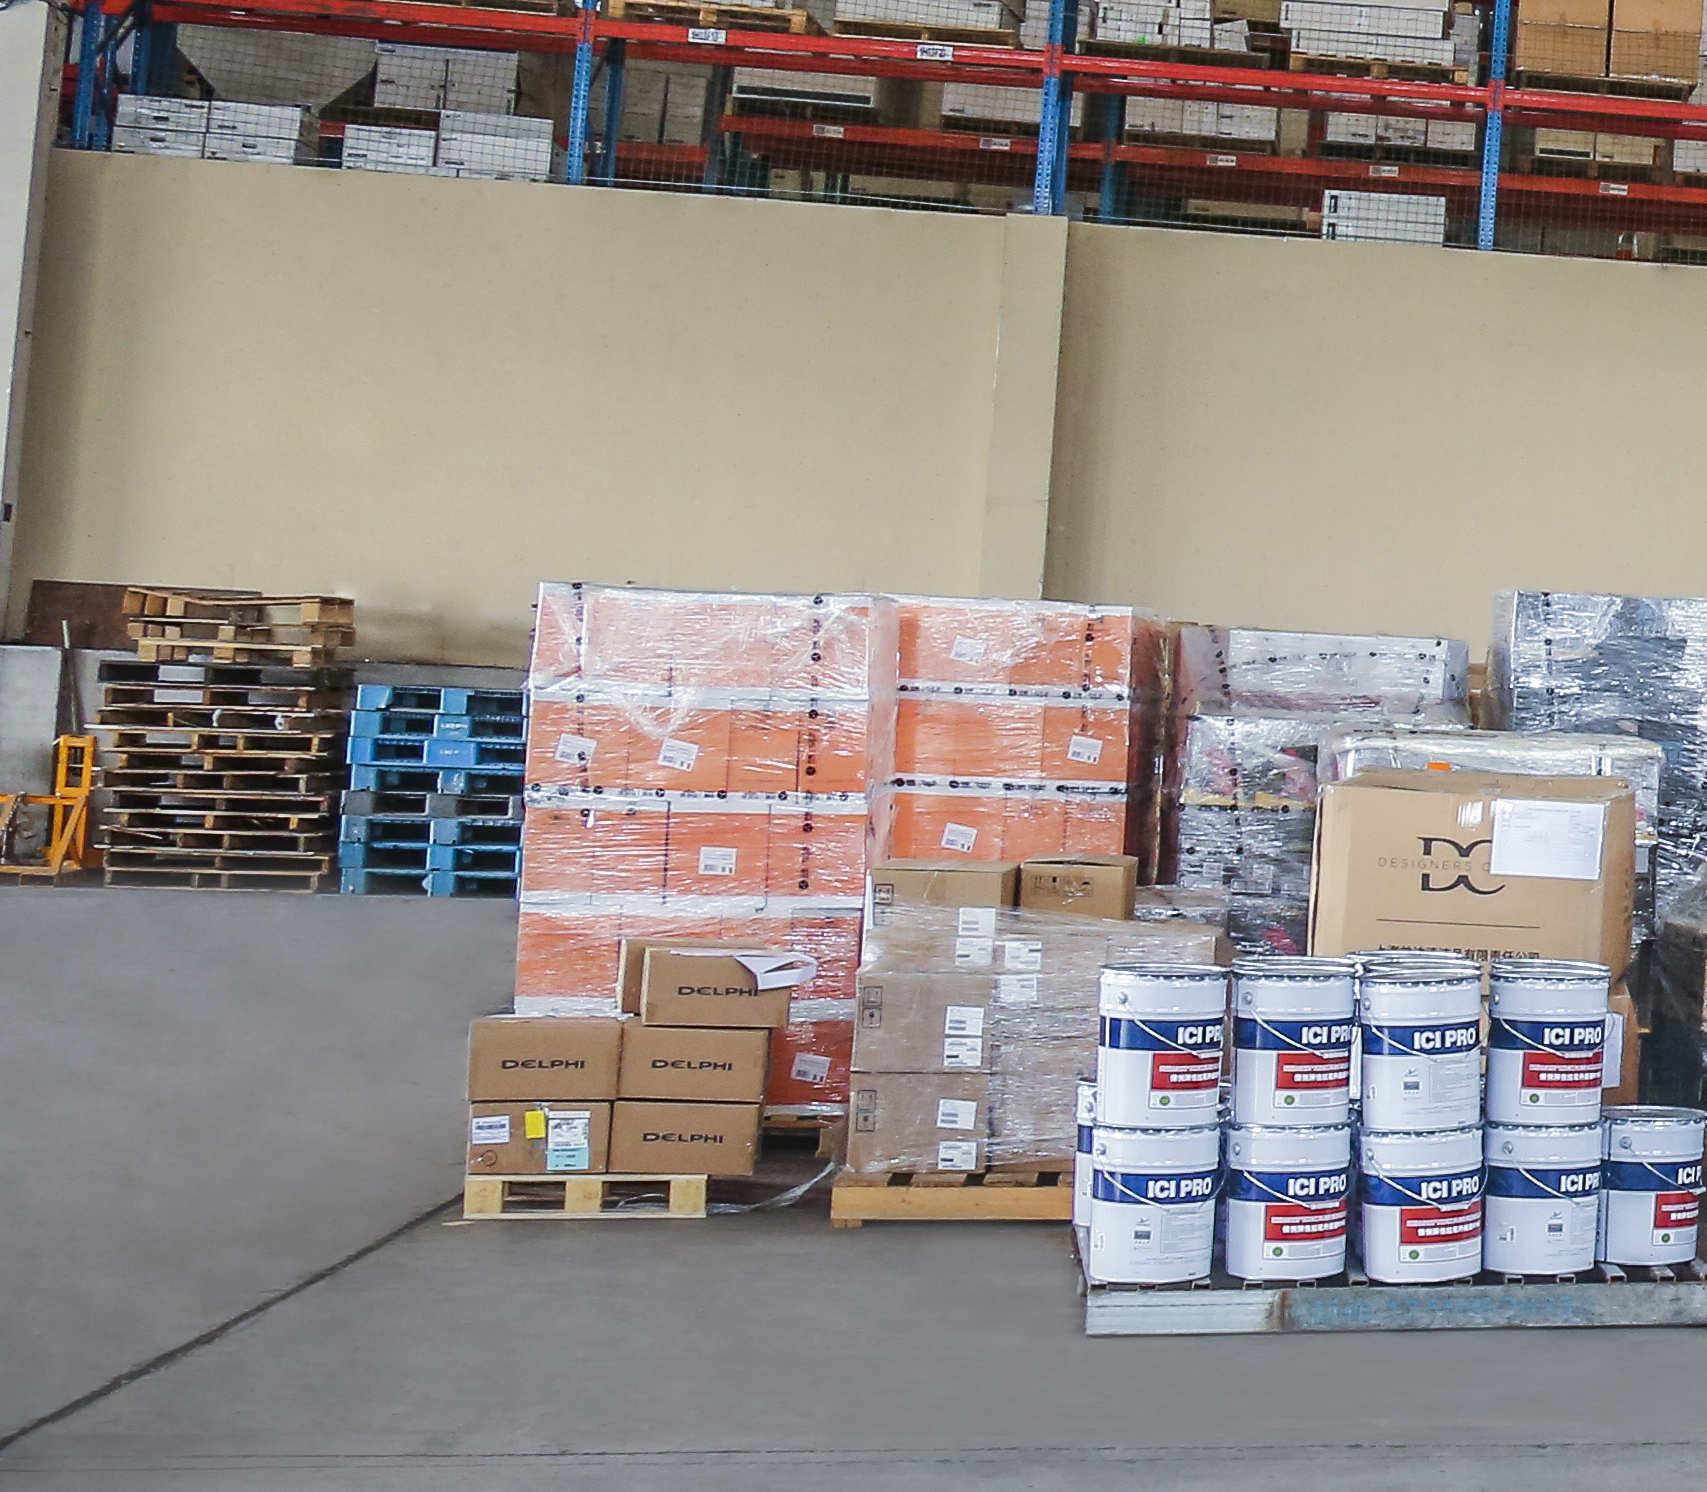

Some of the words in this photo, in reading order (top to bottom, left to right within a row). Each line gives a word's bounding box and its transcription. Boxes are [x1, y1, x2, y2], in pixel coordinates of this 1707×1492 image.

[1378, 857, 1473, 871] DESIGNERS
[678, 986, 758, 997] DELPHI
[1177, 1026, 1204, 1045] ICI
[1301, 1026, 1329, 1045] ICI
[1413, 1029, 1442, 1050] ICI
[1444, 1025, 1477, 1047] PRO
[1543, 1026, 1572, 1046] ICI
[1573, 1025, 1603, 1045] PRO
[501, 1059, 585, 1070] DELPHI
[652, 1059, 733, 1072] DELPHI
[642, 1132, 724, 1144] DELPHI
[1287, 1177, 1317, 1196] ICI
[1317, 1174, 1347, 1195] PRO
[1559, 1173, 1583, 1192] ICI
[1677, 1168, 1695, 1185] ICI
[1147, 1180, 1178, 1199] ICI
[1179, 1177, 1213, 1197] PRO
[1420, 1179, 1449, 1201] ICI
[1450, 1175, 1480, 1198] PRO
